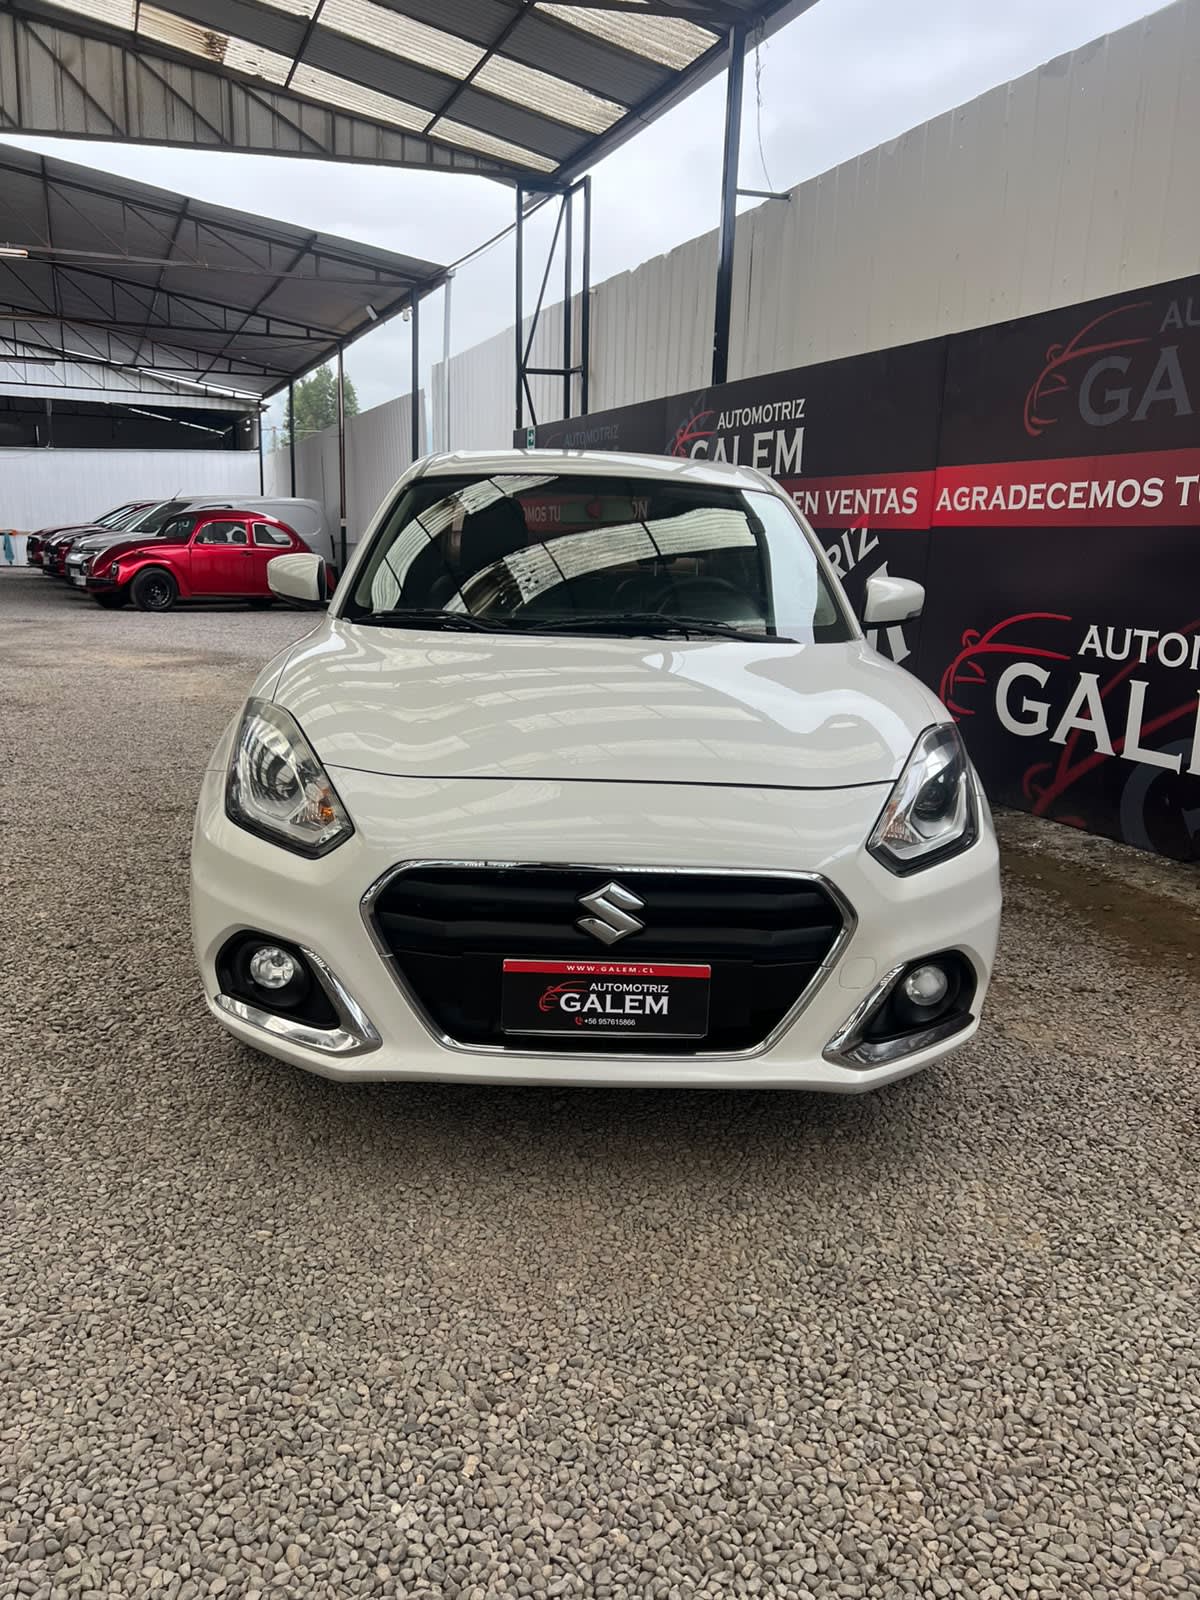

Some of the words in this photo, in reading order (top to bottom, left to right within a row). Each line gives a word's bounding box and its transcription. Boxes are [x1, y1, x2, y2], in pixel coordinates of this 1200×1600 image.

[717, 398, 806, 430] AUTOMOTRIZ
[793, 490, 819, 515] EN
[825, 486, 918, 515] VENTAS
[935, 477, 1165, 512] AGRADECEMOS
[996, 662, 1200, 776] GAL
[566, 965, 655, 973] WWW.GALEM.CL
[589, 982, 669, 993] AUTOMOTRIZ
[560, 992, 669, 1015] GALEM
